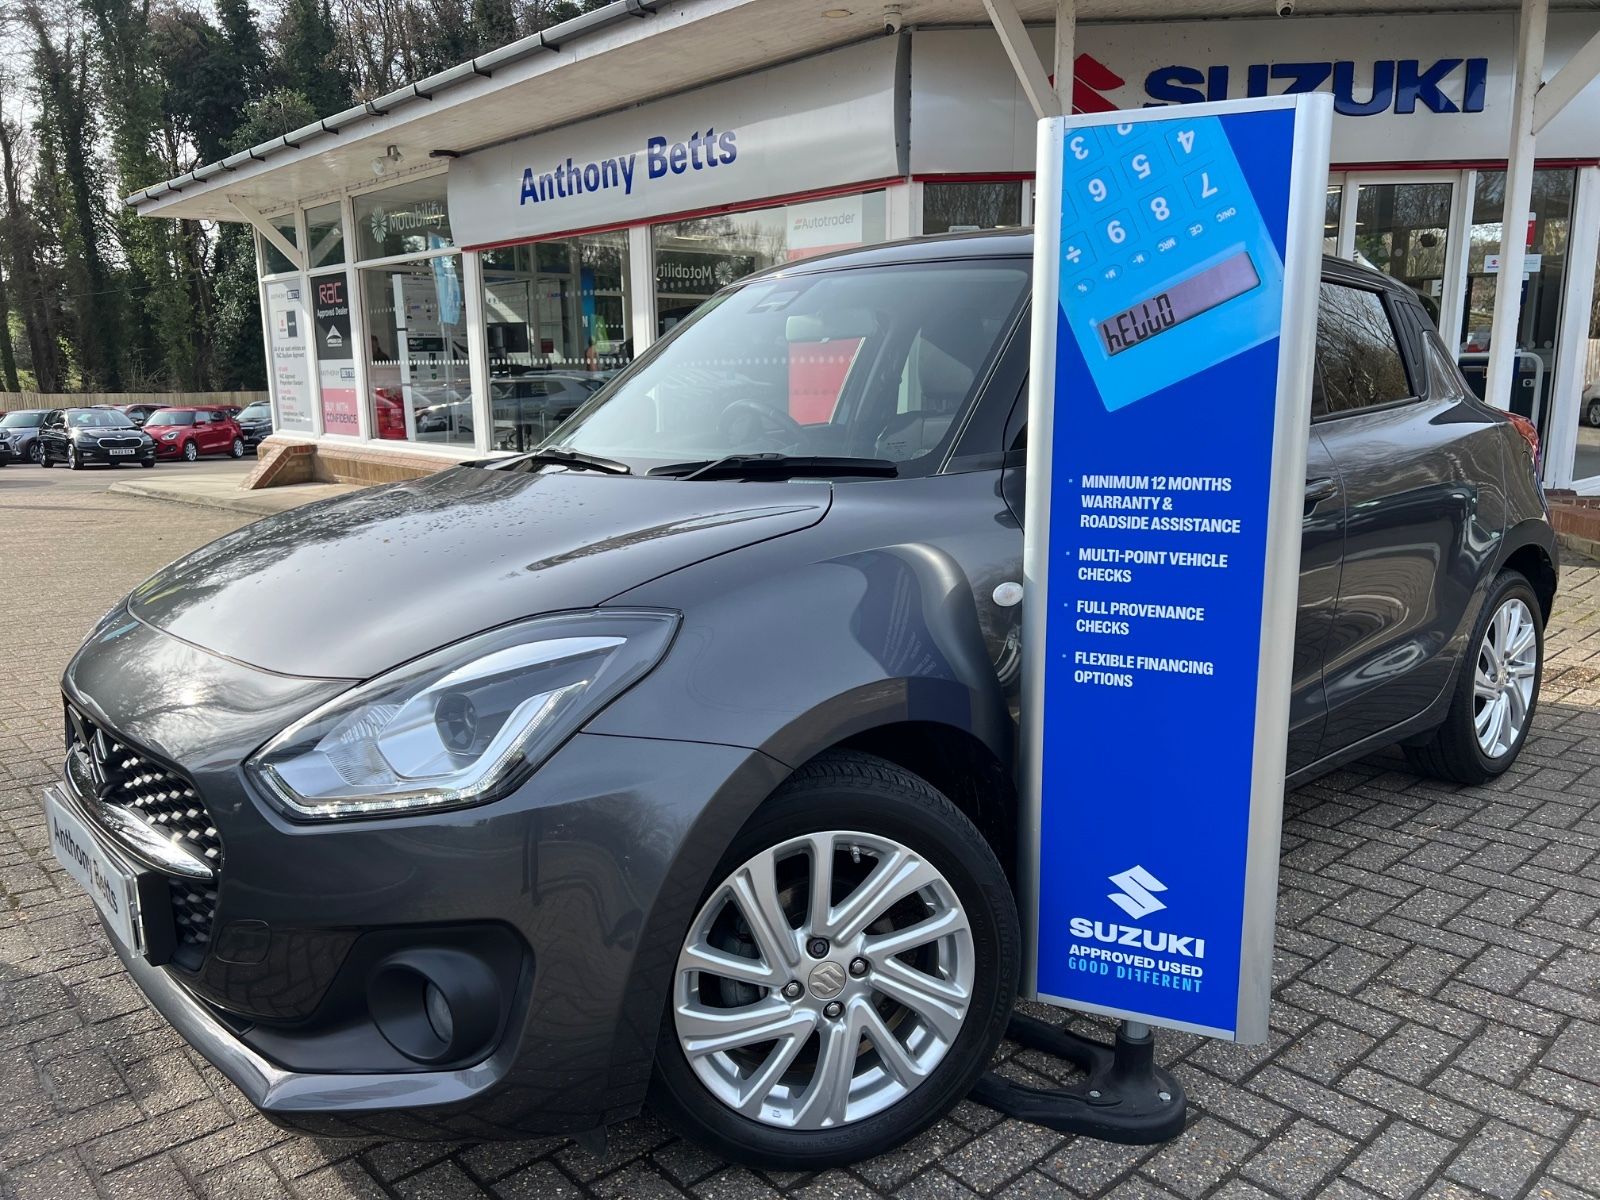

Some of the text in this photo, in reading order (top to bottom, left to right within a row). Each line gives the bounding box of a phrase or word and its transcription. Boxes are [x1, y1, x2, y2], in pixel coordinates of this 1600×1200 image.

[1144, 58, 1488, 117] SUZUKI
[520, 127, 738, 206] Anthony Betts
[802, 212, 855, 231] Autotrader
[317, 305, 349, 318] Approved Dealer
[326, 412, 359, 425] CONFIDENCE
[1081, 475, 1233, 492] MINIMUM 12 MONTHS
[1080, 494, 1174, 512] WARRANTY &
[1080, 514, 1241, 534] ROADSIDE ASSISTANCE
[1078, 548, 1229, 568] MULTI-POINT VEHICLE
[1077, 567, 1132, 583] CHECKS
[1076, 600, 1205, 622] FULL PROVENANCE
[1076, 620, 1130, 636] CHECKS
[1074, 651, 1214, 676] FLEXIBLE FINANCING
[1074, 670, 1134, 688] OPTIONS
[54, 816, 118, 915] Anthony Betts
[1069, 917, 1205, 959] SUZUKI
[1069, 944, 1203, 978] APPROVED USED
[1068, 956, 1202, 993] GOOD DIFFERENT
